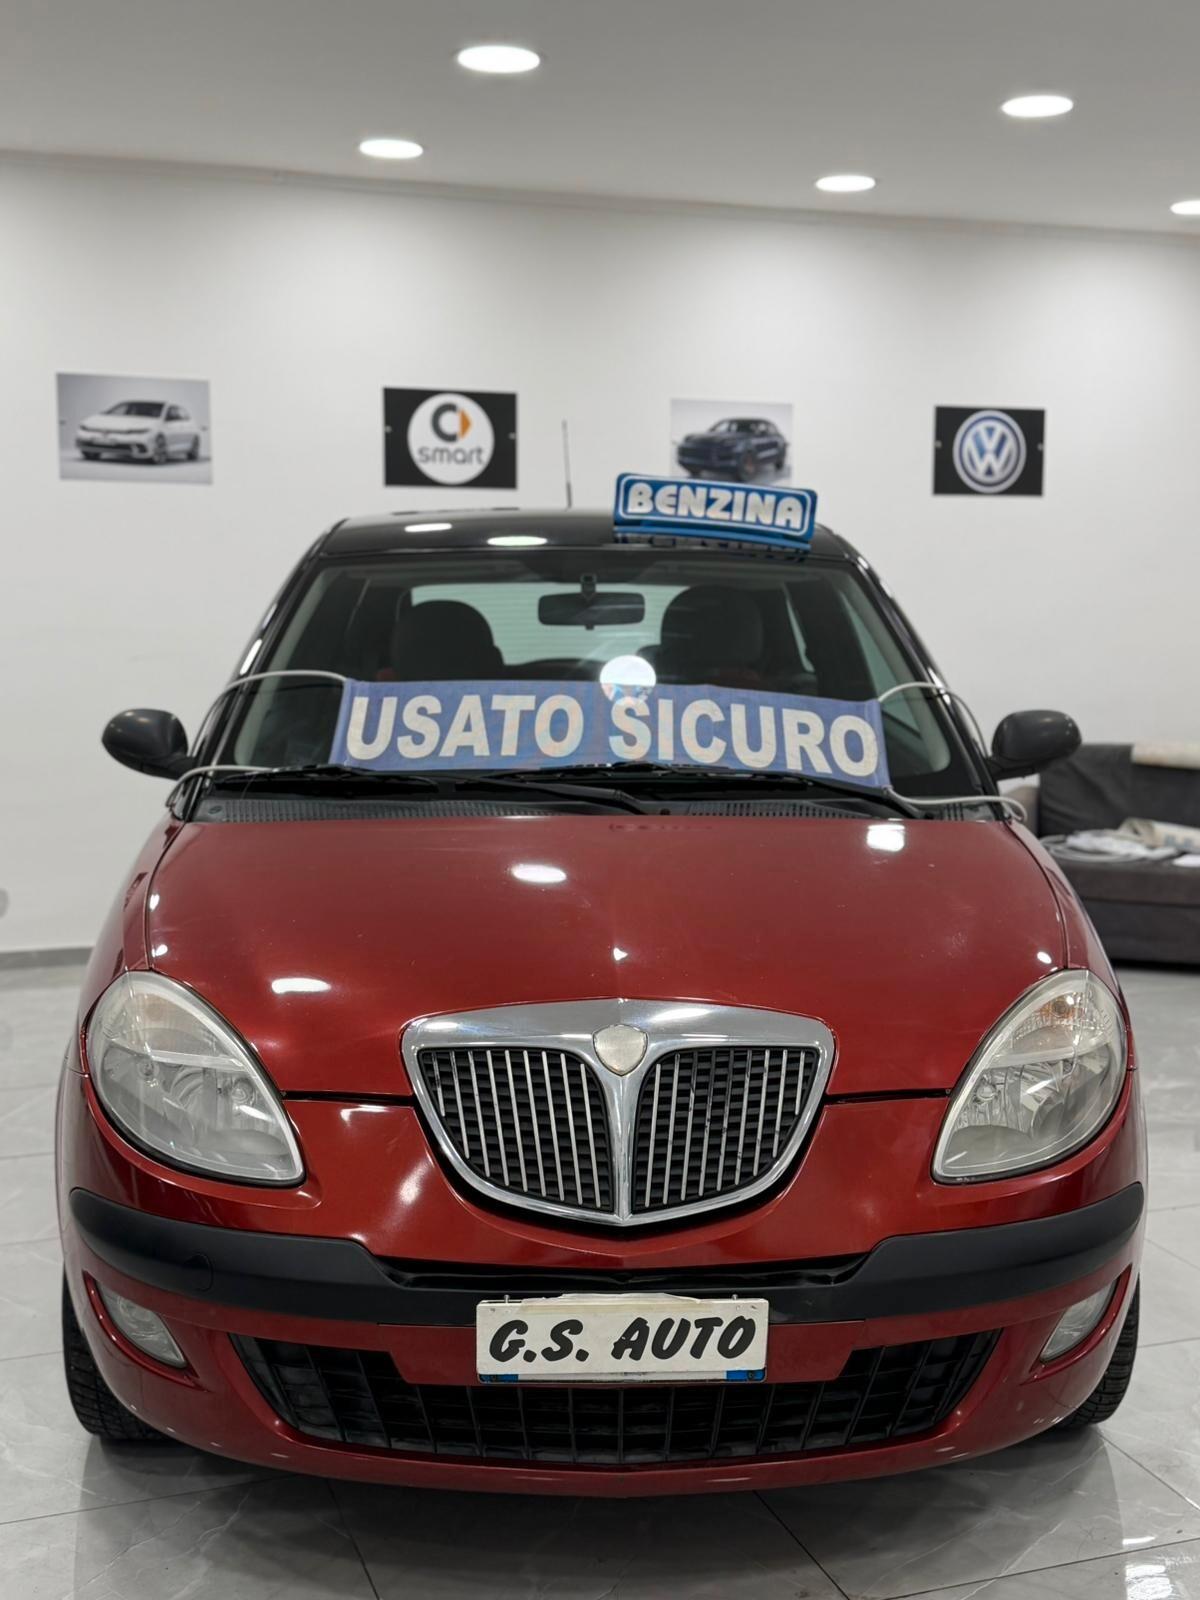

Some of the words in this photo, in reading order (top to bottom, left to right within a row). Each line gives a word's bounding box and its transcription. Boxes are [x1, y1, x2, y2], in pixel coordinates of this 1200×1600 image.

[417, 446, 485, 465] smart
[626, 481, 804, 530] BENZINA
[346, 694, 584, 760] USATO
[608, 696, 879, 777] SICURO
[488, 1319, 590, 1363] G.S.
[610, 1315, 757, 1361] AUTO
